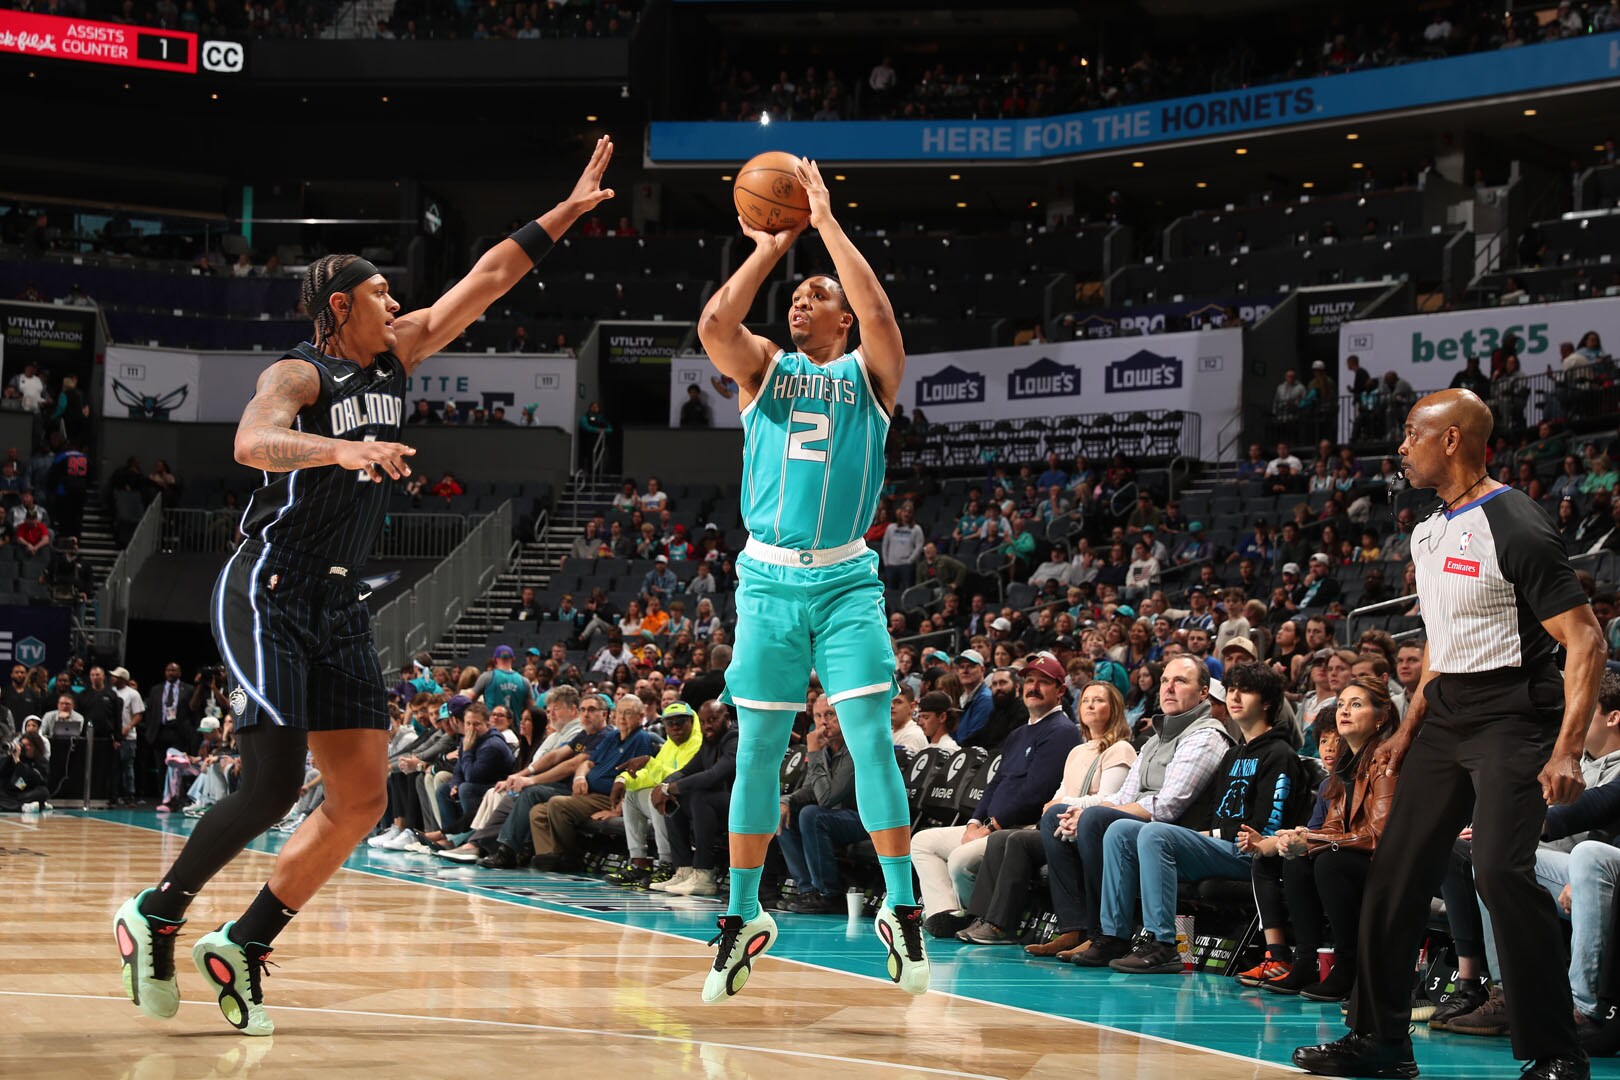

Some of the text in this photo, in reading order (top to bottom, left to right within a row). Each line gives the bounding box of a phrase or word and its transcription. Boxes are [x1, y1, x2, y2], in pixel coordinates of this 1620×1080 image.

[67, 24, 125, 43] ASSISTS
[62, 39, 128, 59] COUNTER
[160, 39, 167, 59] 1
[207, 46, 239, 68] CC
[922, 86, 1323, 153] HERE FOR THE HORNETS.
[1309, 301, 1355, 315] UTILITY
[8, 316, 56, 330] UTILITY
[22, 328, 83, 342] INNOVATION
[610, 336, 654, 347] UTILITY
[1354, 337, 1368, 347] 112
[1412, 323, 1549, 363] bet365
[623, 347, 676, 357] INNOVATIO
[1015, 372, 1075, 395] LOWE'S
[1112, 363, 1175, 389] LOWE'S
[773, 374, 857, 405] HORNETS
[922, 381, 979, 402] LOWE'S
[787, 410, 830, 463] 2
[1447, 560, 1476, 573] Emirates
[20, 645, 43, 659] TV
[1429, 976, 1441, 991] 3
[1605, 1005, 1617, 1020] 5
